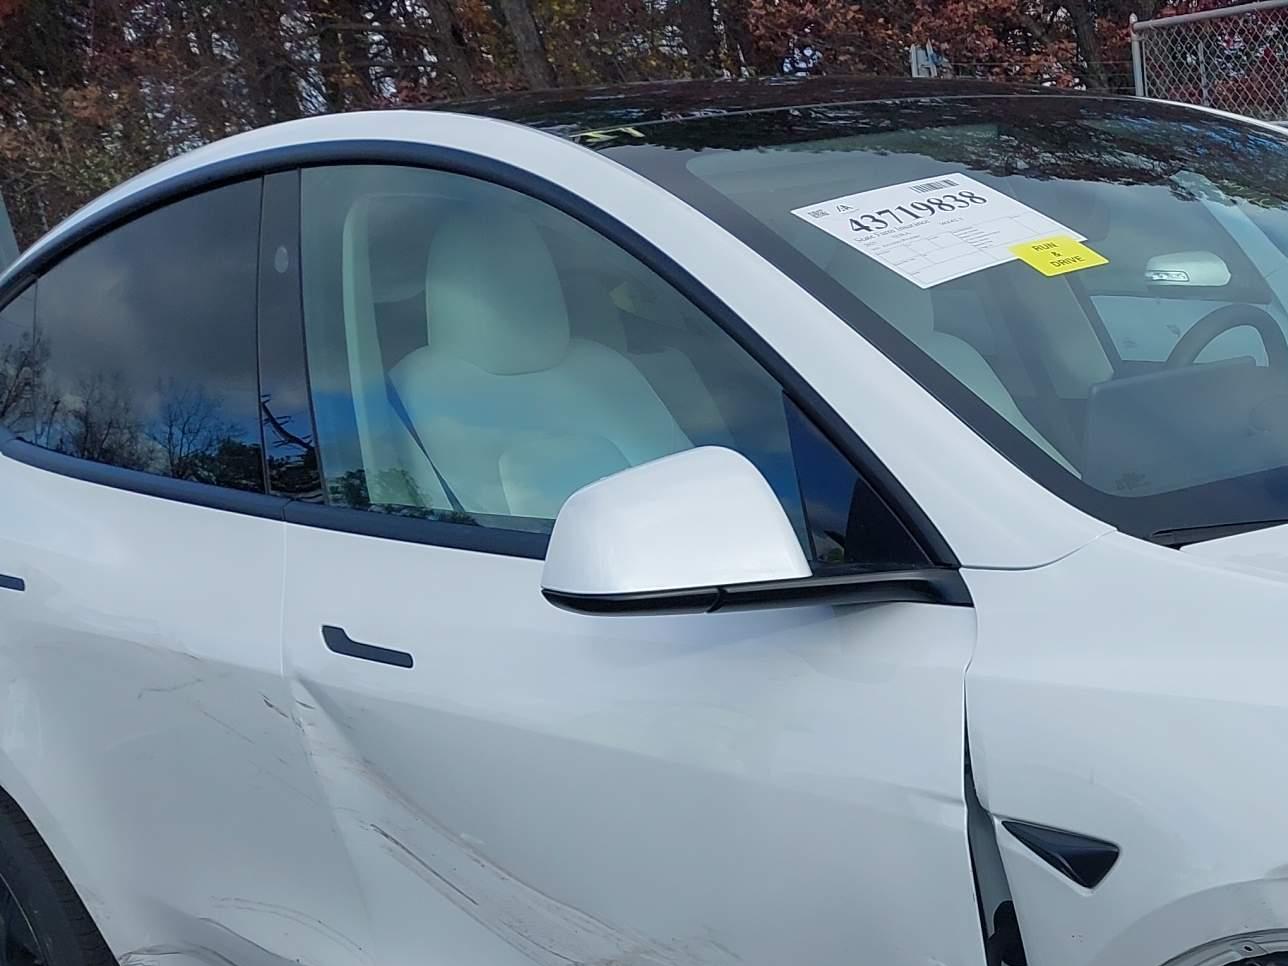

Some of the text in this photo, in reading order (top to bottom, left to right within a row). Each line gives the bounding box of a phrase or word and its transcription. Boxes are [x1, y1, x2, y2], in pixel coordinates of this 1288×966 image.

[850, 190, 988, 232] 43719838
[1032, 242, 1059, 252] RUN
[1050, 255, 1086, 268] DRIVE
